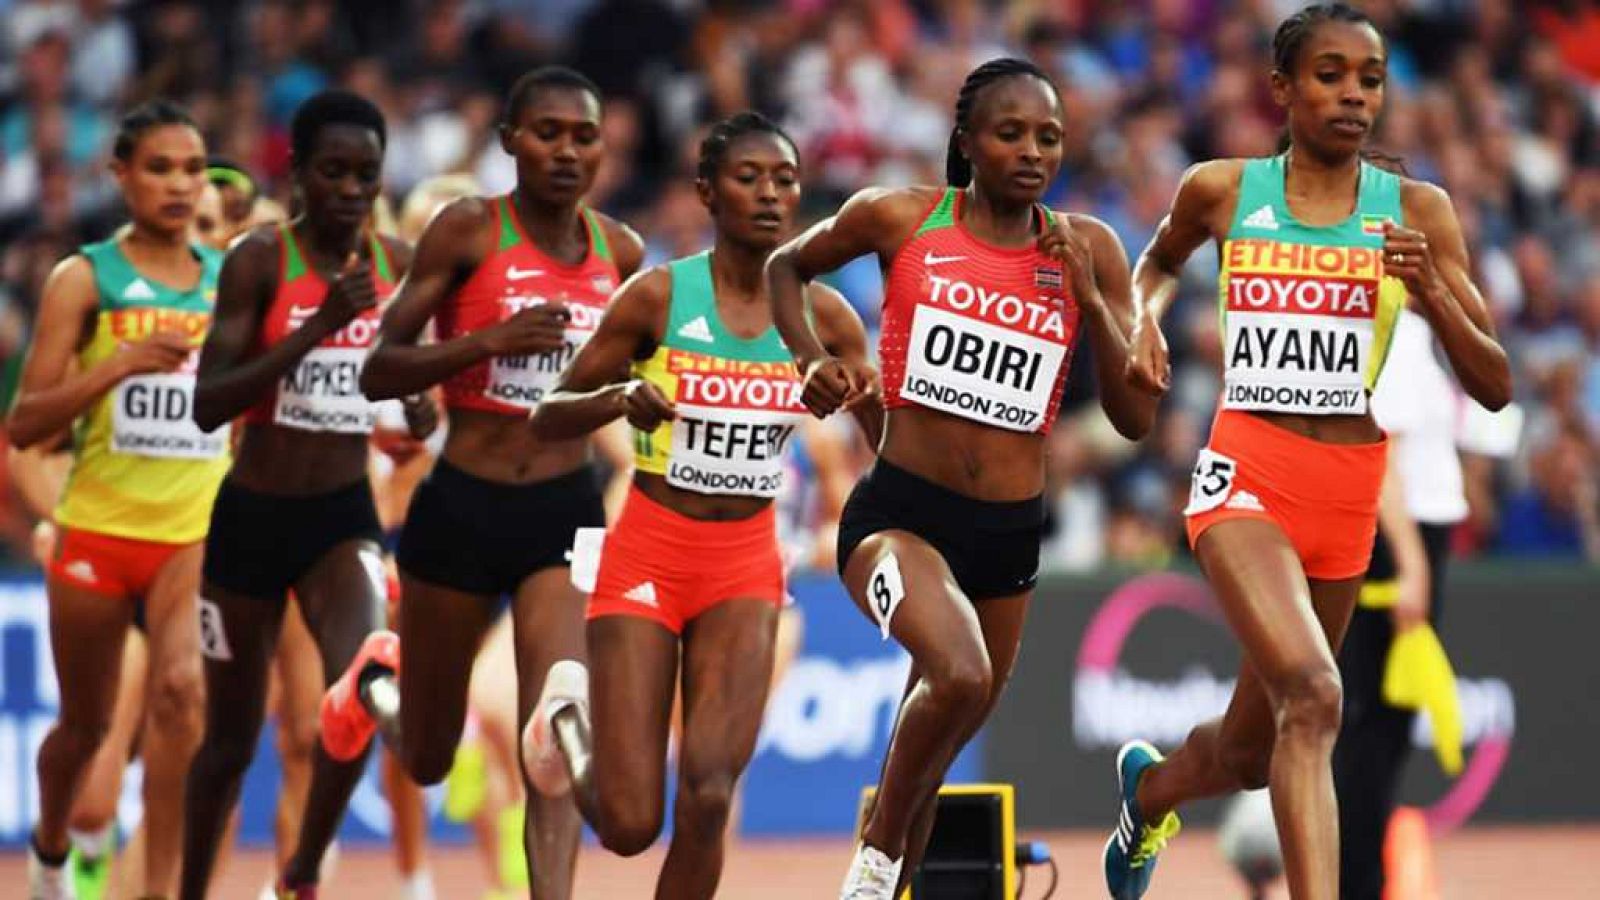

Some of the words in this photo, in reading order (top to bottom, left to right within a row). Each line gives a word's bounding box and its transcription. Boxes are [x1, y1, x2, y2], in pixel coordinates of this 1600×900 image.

[929, 275, 1065, 339] TOYOTA
[1231, 278, 1370, 313] TOYOTA
[924, 324, 1043, 392] OBIRI
[1231, 326, 1360, 373] AYANA
[681, 373, 807, 410] TOYOTA
[907, 375, 990, 415] LONDON
[993, 402, 1039, 426] 2017
[1228, 385, 1311, 406] LONDON
[671, 463, 755, 489] LONDON
[874, 572, 891, 617] 8
